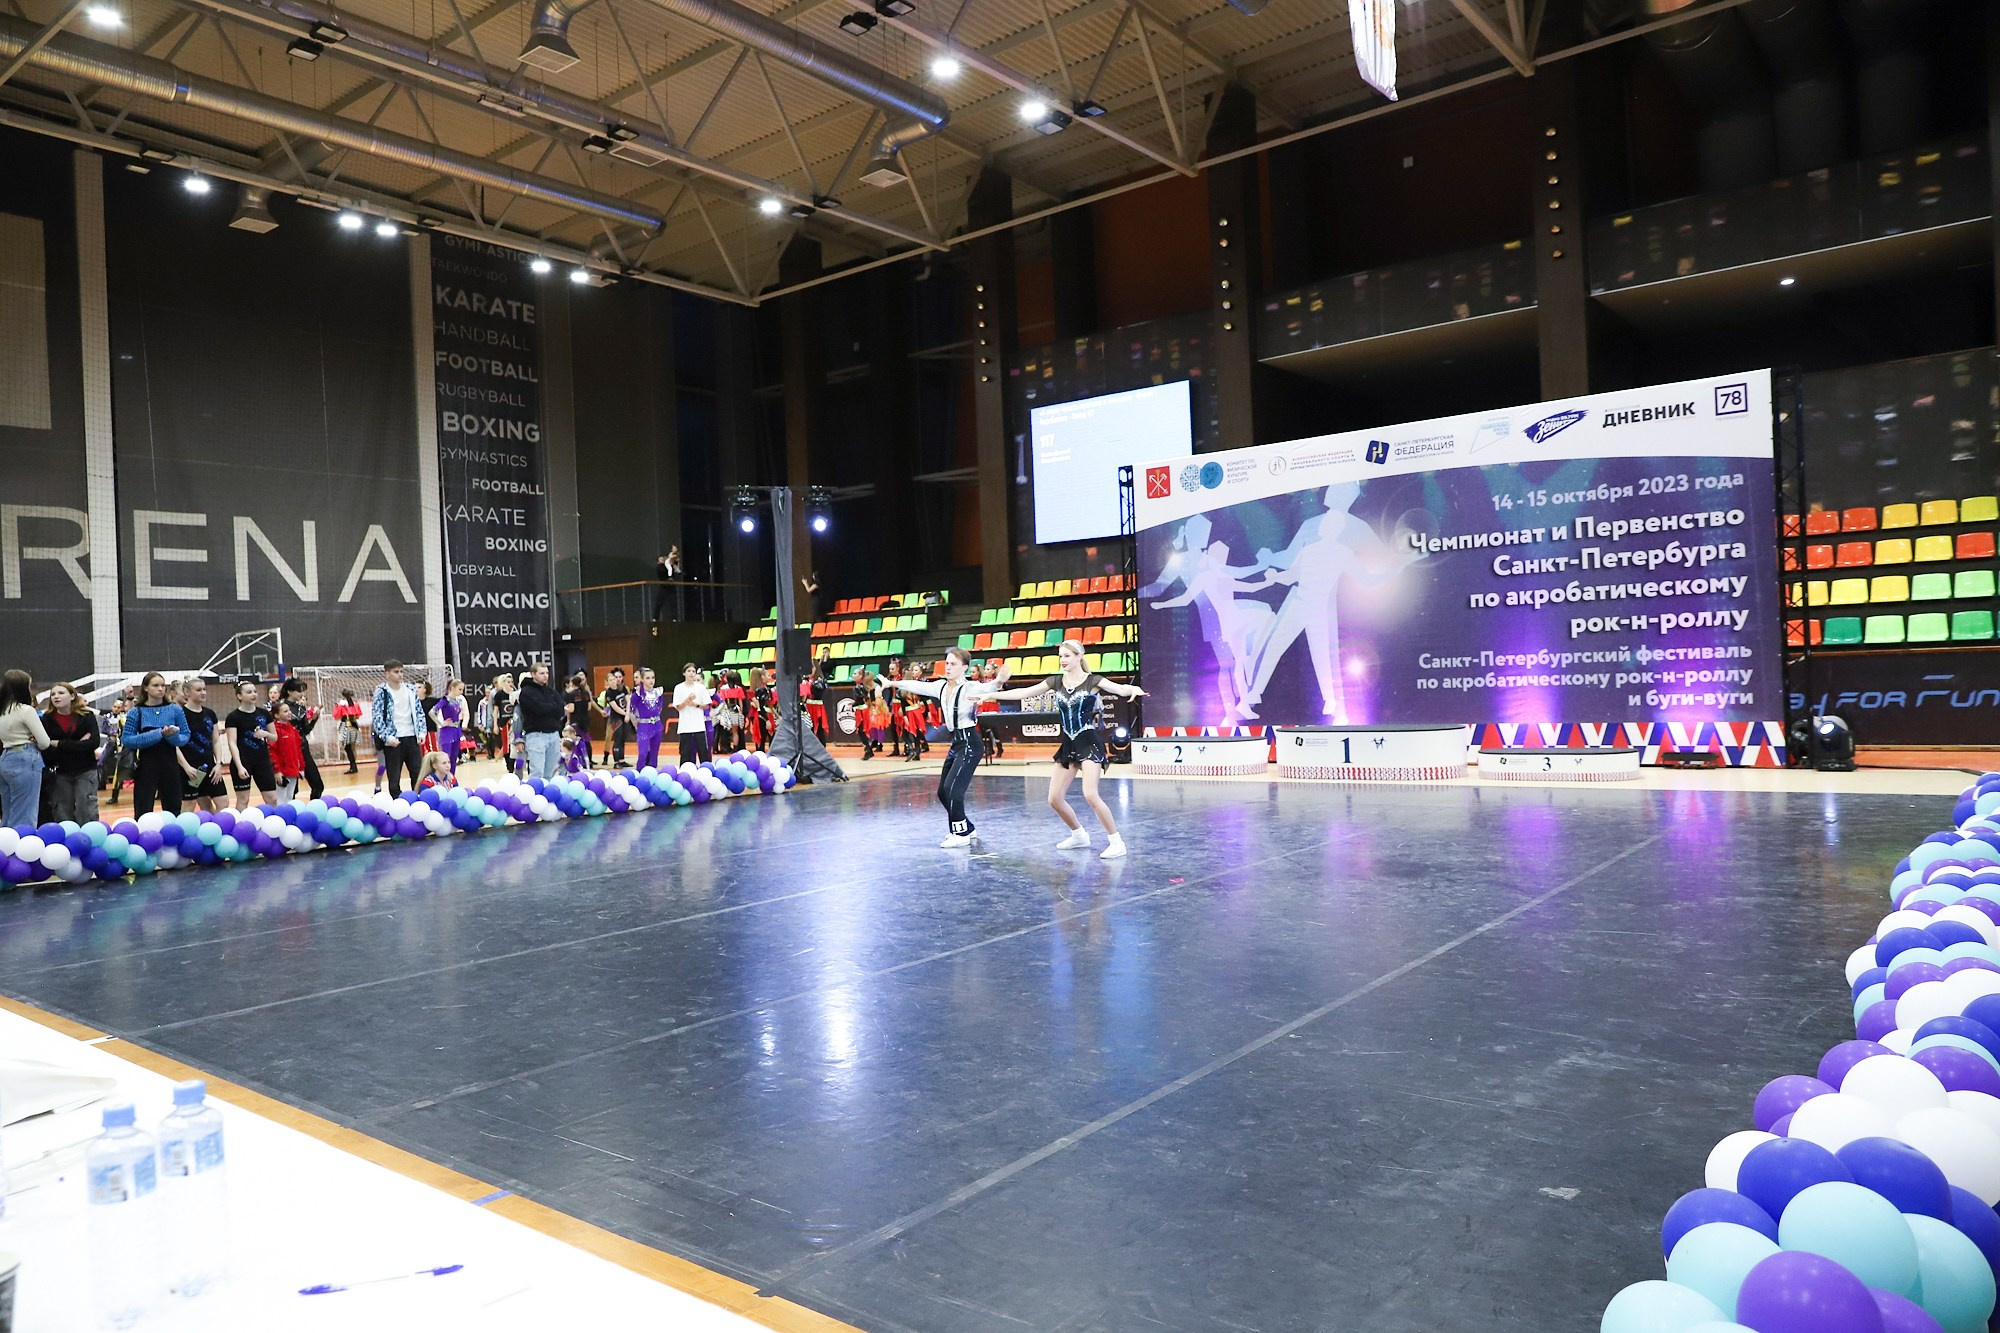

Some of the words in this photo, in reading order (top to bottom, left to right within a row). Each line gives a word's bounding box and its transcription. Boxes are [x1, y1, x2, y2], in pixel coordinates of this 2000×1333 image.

[436, 284, 535, 324] KARATE
[435, 320, 532, 351] HANDBALL
[436, 351, 538, 382] FOOTBALL
[437, 382, 526, 407] RUGBYBALL
[1720, 390, 1742, 409] 78
[443, 411, 540, 443] BOXING
[1602, 401, 1695, 429] ДНЕВНИК
[1394, 440, 1454, 456] ФЕДЕРАЦИЯ
[472, 478, 544, 495] FOOTBALL
[1492, 494, 1513, 511] 14
[1529, 490, 1547, 508] 15
[1552, 480, 1633, 505] октября
[1638, 474, 1690, 496] 2023
[1694, 472, 1744, 491] года
[443, 504, 526, 526] KARATE
[1410, 525, 1546, 554] Чемпионат
[1552, 524, 1567, 541] и
[1574, 508, 1745, 542] Первенство
[485, 537, 547, 552] BOXING
[451, 564, 516, 577] UGBYBALL
[1492, 540, 1747, 577] Санкт-Петербурга
[456, 592, 549, 609] DANCING
[1470, 590, 1500, 609] по
[1506, 574, 1748, 610] акробатическому
[455, 624, 536, 636] ASKETBALL
[1570, 608, 1749, 639] рок-н-роллу
[471, 651, 551, 668] KARATE
[1418, 643, 1631, 669] Санкт-Петербургский
[1636, 643, 1753, 665] фестиваль
[1416, 677, 1439, 691] по
[1442, 670, 1610, 693] акробатическому
[1615, 668, 1753, 688] рок-н-роллу
[1628, 692, 1641, 706] и
[1646, 689, 1753, 711] буги-вуги
[1174, 745, 1183, 763] 2
[1340, 737, 1352, 764] 1
[1542, 756, 1551, 772] 3
[953, 823, 965, 833] 11
